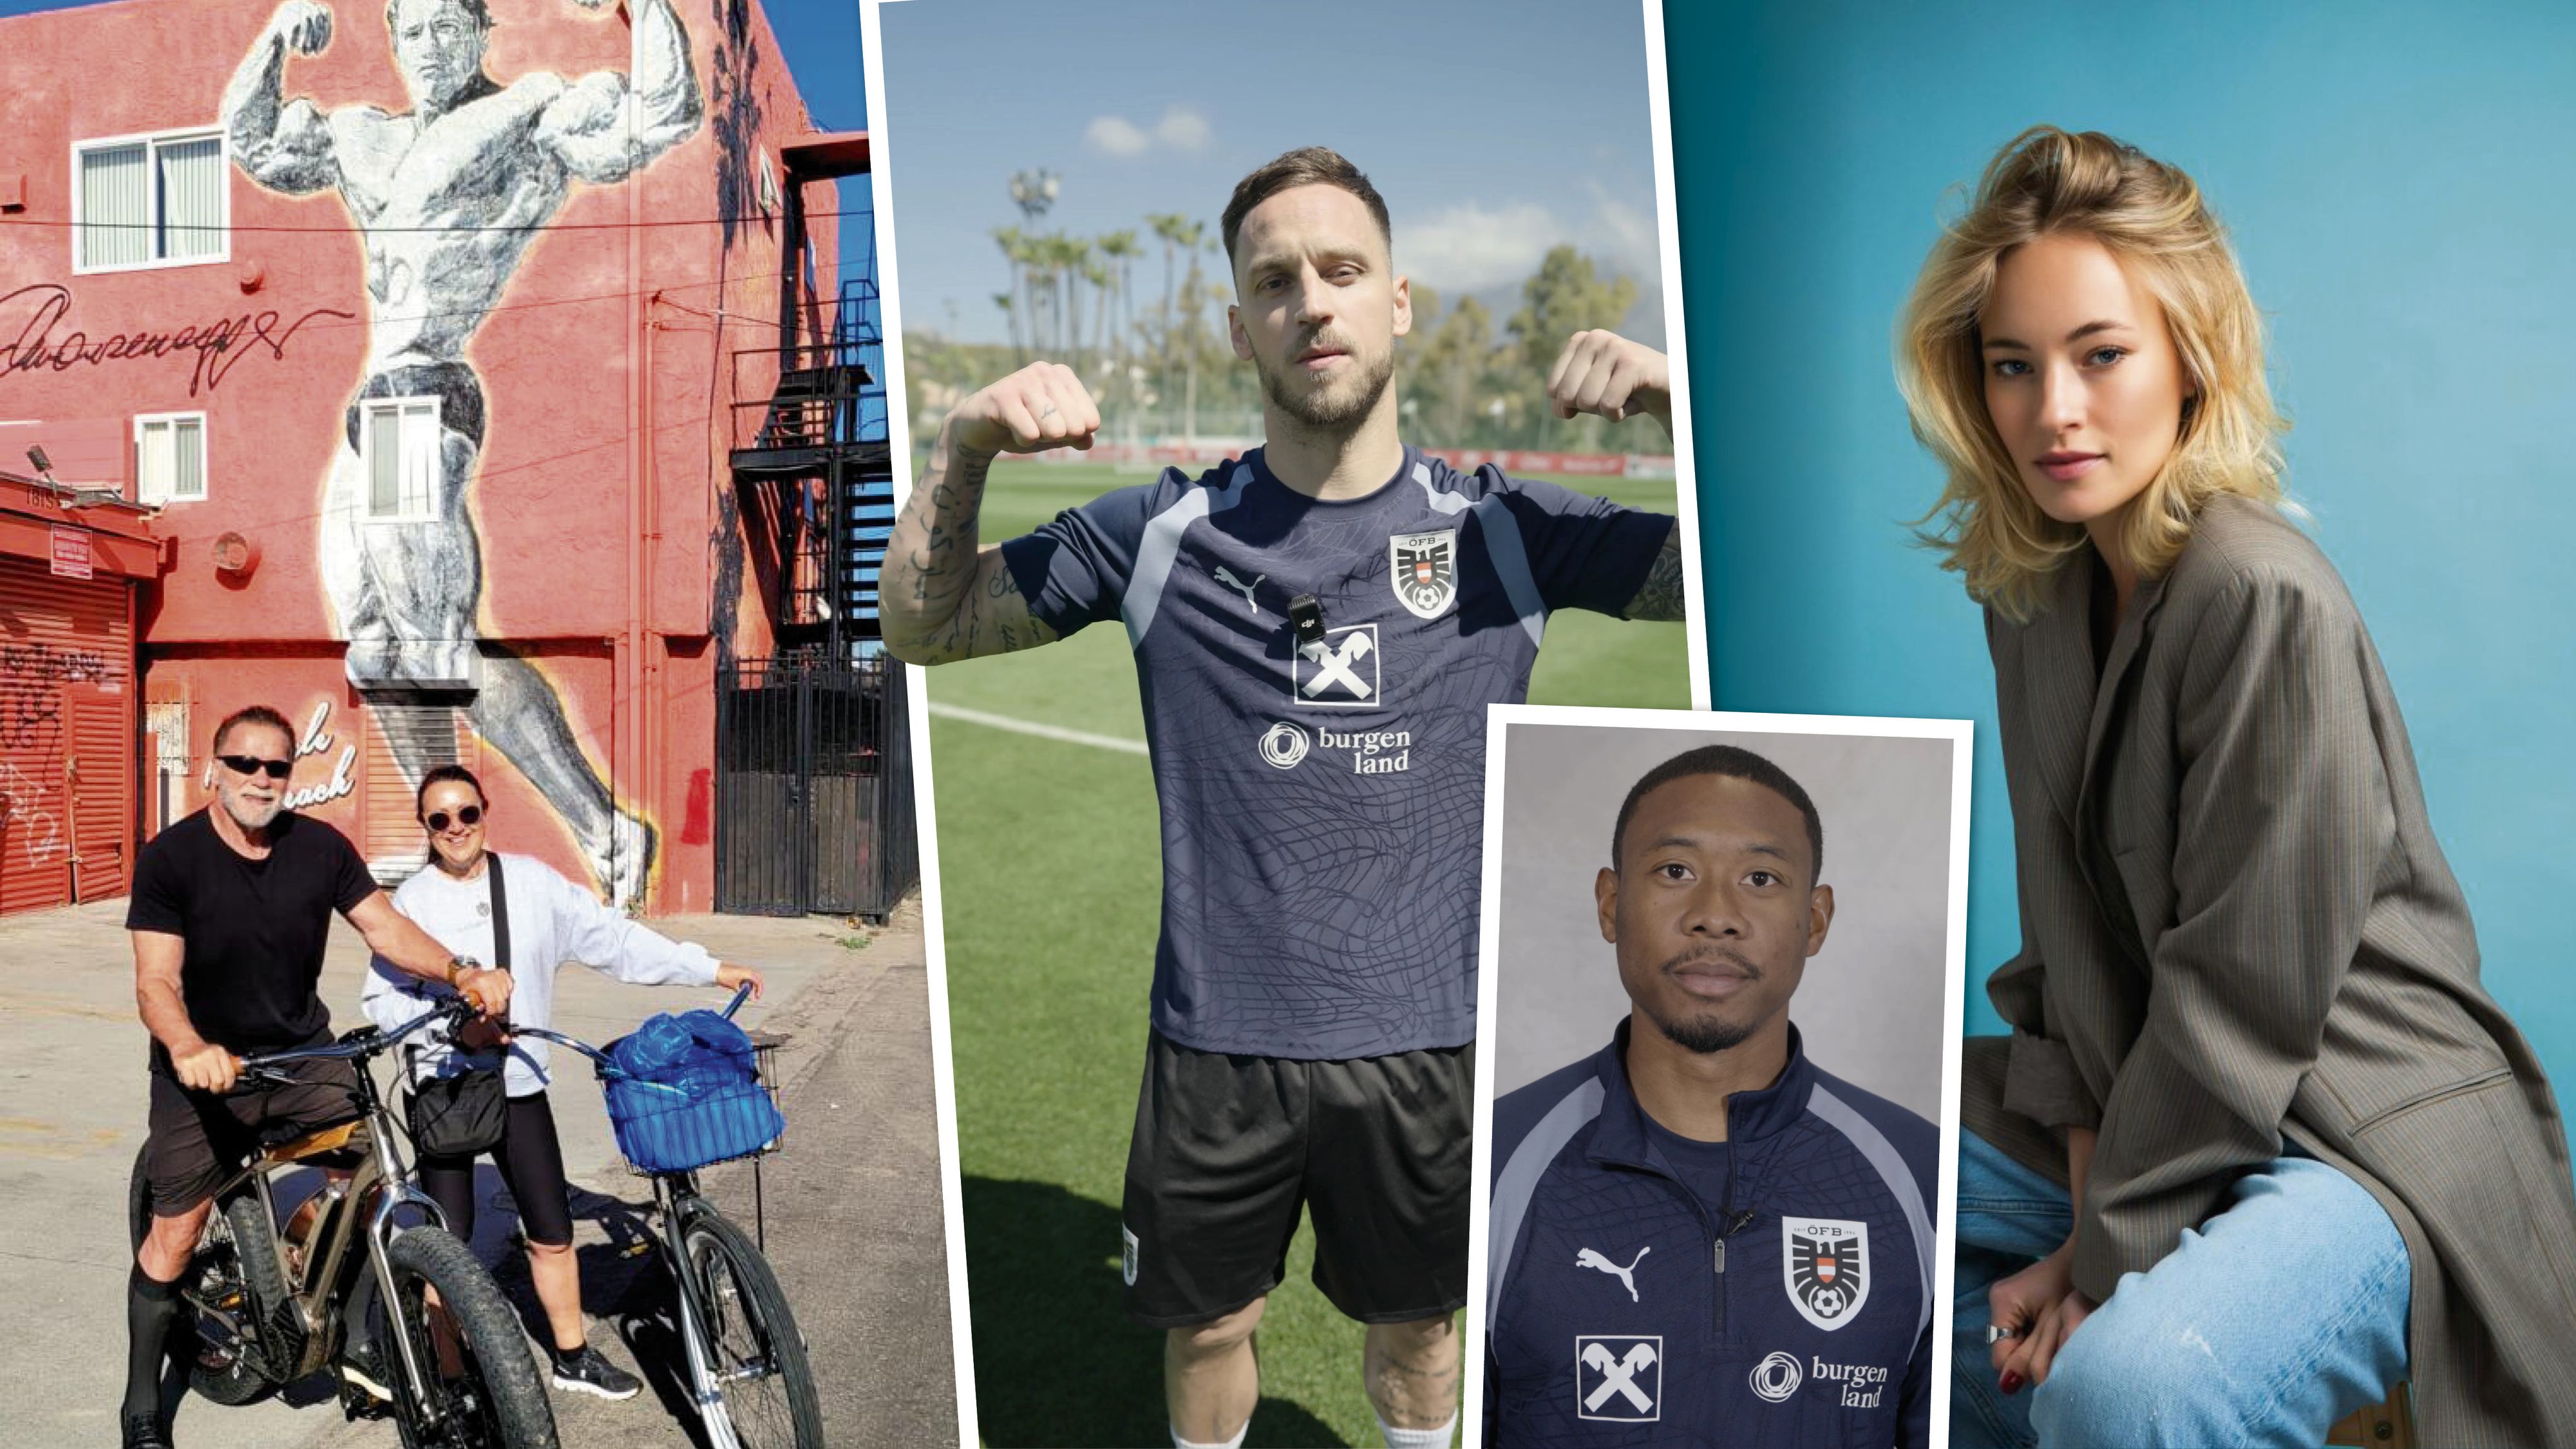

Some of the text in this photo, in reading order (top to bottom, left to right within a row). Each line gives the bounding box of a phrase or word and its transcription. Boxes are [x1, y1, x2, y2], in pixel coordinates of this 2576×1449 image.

[1409, 537, 1435, 546] ÖFB
[1318, 726, 1411, 755] burgen
[1354, 749, 1409, 774] land
[1807, 1224, 1842, 1236] ÖFB
[1812, 1356, 1888, 1388] burgen
[1841, 1384, 1883, 1408] land
